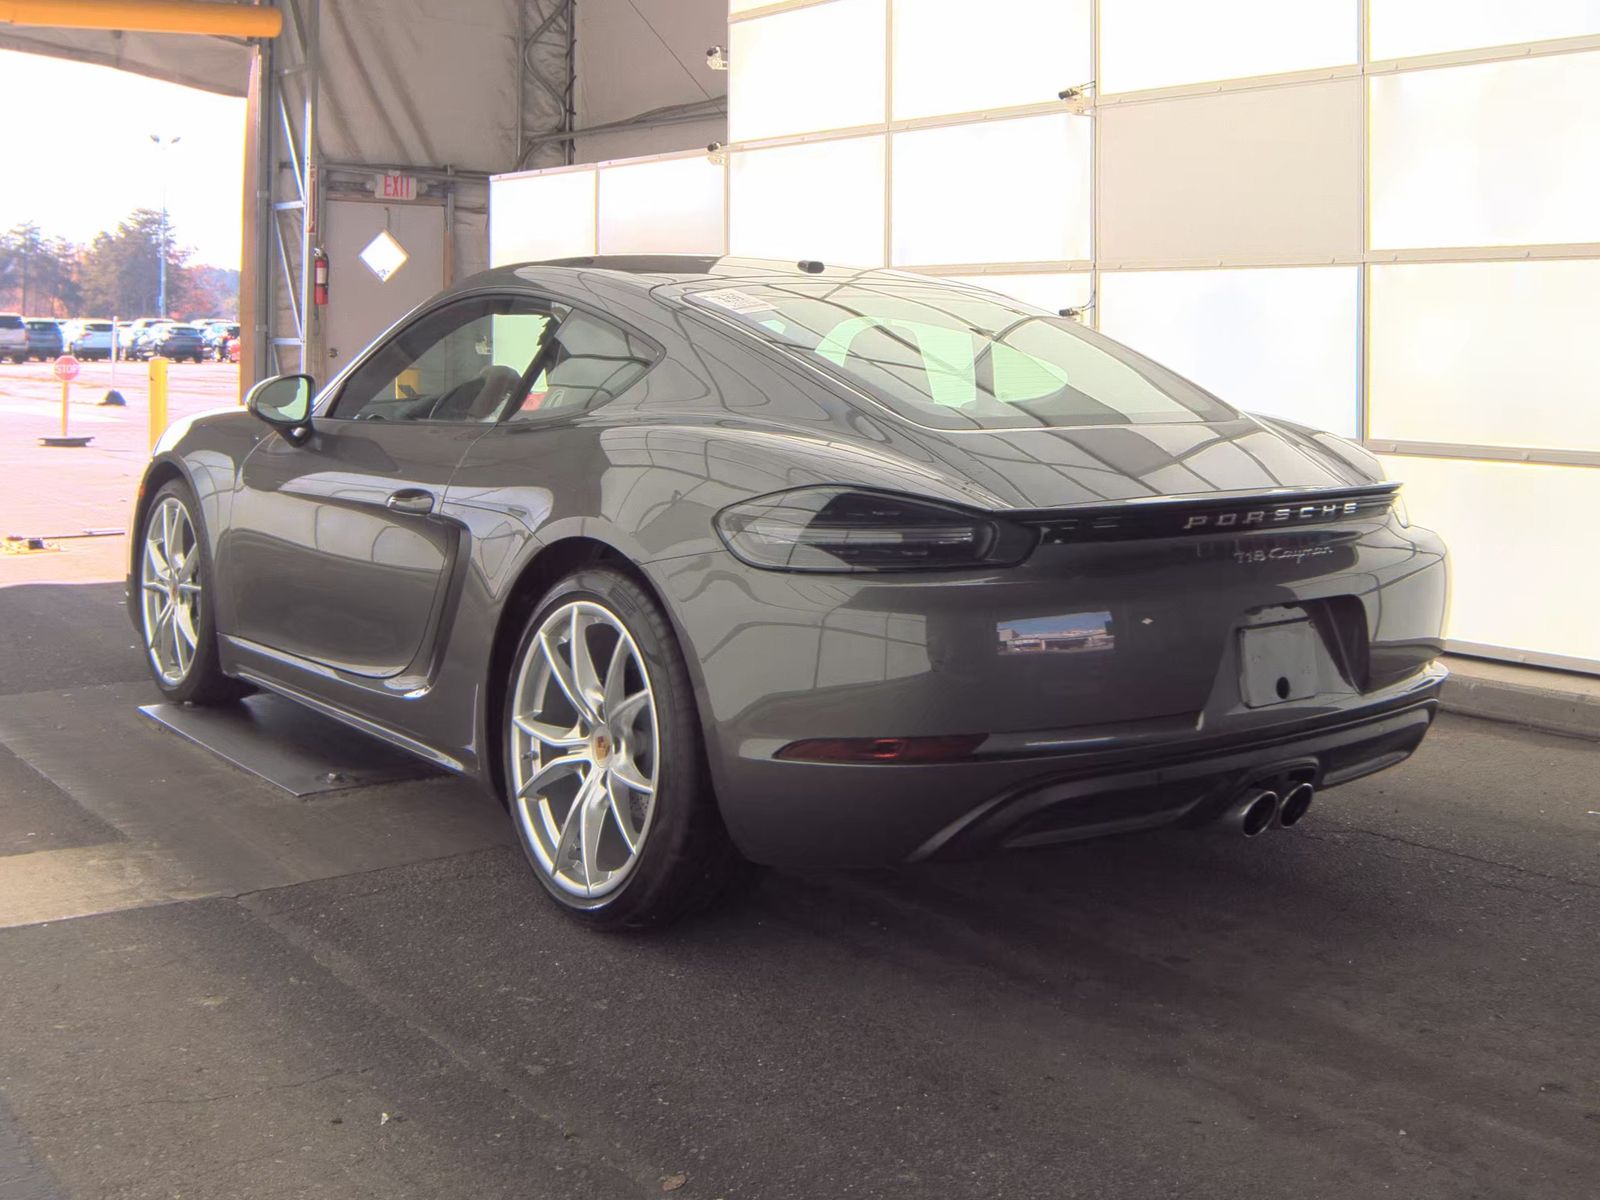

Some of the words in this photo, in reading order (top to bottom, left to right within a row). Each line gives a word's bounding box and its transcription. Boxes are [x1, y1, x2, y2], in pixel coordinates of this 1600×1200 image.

[383, 175, 411, 198] EXIT
[1184, 503, 1357, 529] PORSCHE
[1233, 550, 1266, 564] 718
[1268, 546, 1334, 565] Cayman
